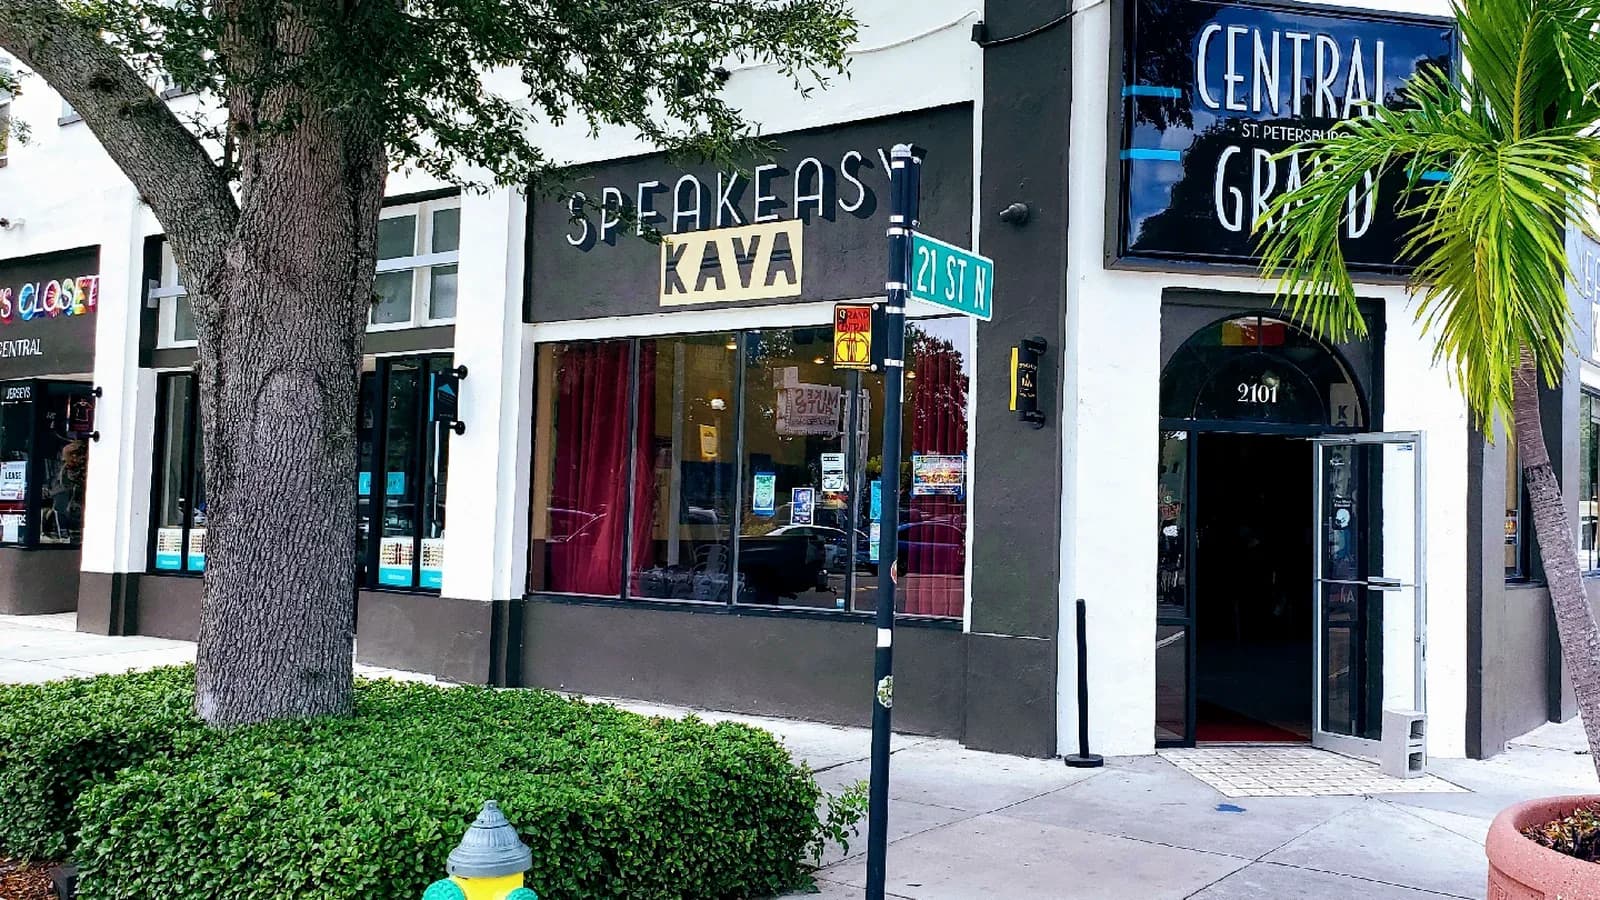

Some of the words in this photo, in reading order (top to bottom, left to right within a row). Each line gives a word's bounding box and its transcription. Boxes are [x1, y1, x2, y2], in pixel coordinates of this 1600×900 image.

[1197, 24, 1387, 123] CENTRAL
[1241, 122, 1260, 139] ST.
[663, 231, 798, 295] KAVA
[916, 246, 937, 295] 21
[945, 255, 967, 304] ST
[974, 264, 986, 310] N
[18, 275, 99, 320] CLOSET
[6, 386, 31, 400] JERSEYS
[1237, 382, 1278, 403] 2101
